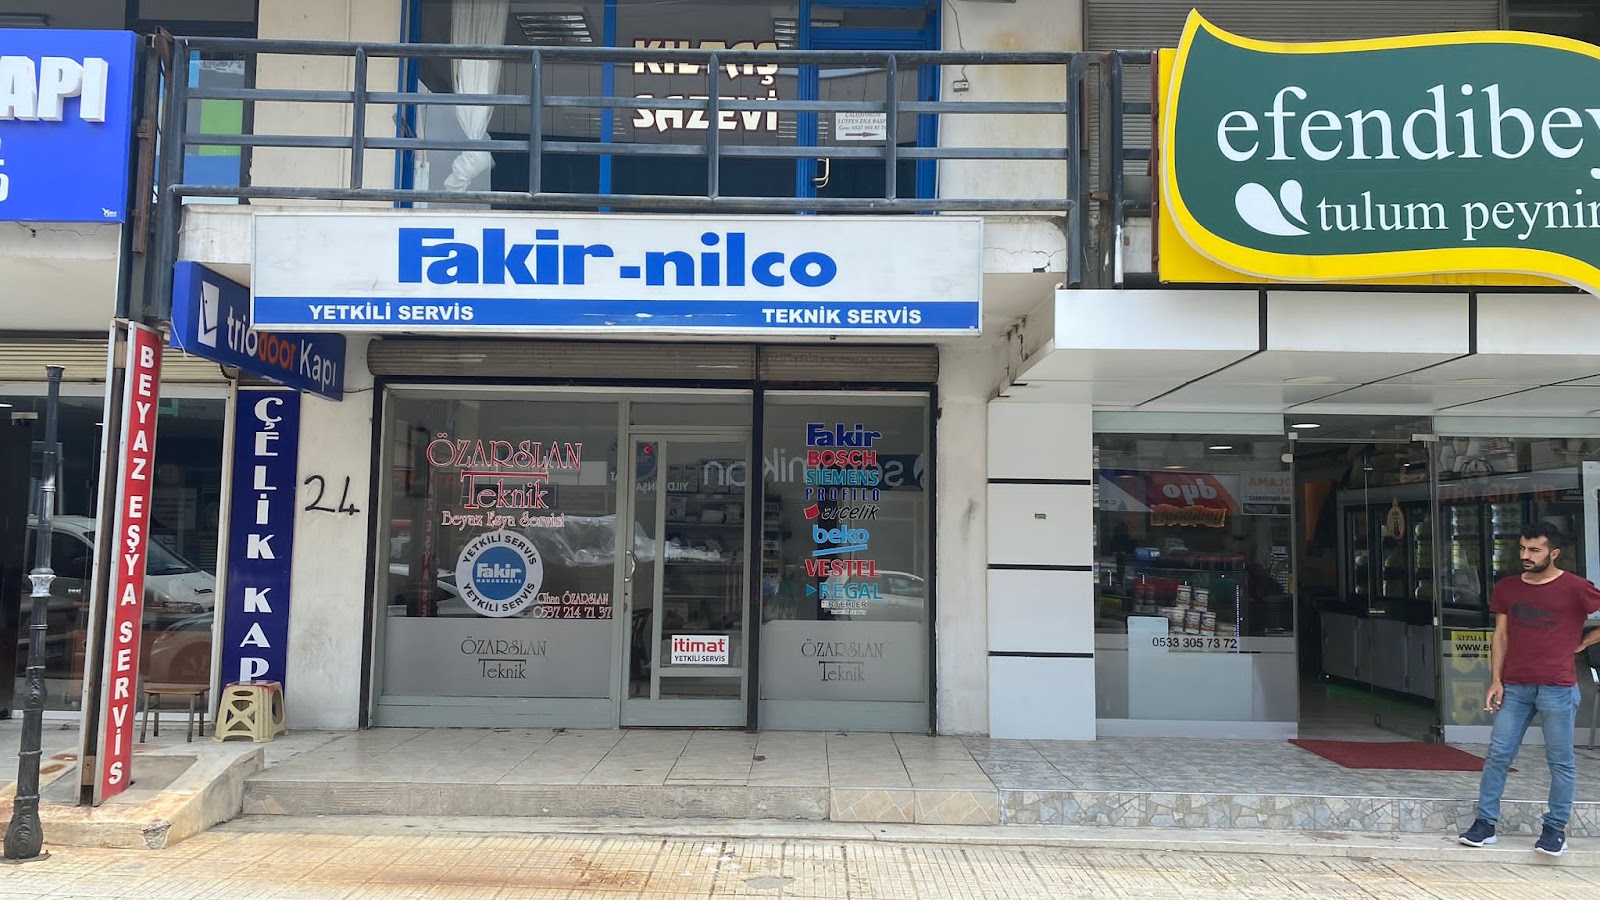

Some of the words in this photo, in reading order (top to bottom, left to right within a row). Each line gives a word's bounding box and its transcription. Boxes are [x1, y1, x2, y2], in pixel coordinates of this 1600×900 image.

[632, 89, 778, 132] SAZEVİ
[1316, 191, 1449, 231] tulum
[309, 302, 391, 320] YETKİLİ
[398, 302, 474, 320] SERVİS
[762, 306, 841, 324] TEKNİK
[847, 306, 922, 324] SERVİS
[300, 339, 337, 392] Kapı
[131, 345, 155, 480] BEYAZ
[806, 422, 882, 447] Fakir
[426, 432, 583, 471] ÖZARSLAN
[807, 450, 877, 467] BOSCH
[246, 397, 283, 560] ÇELİK
[805, 468, 880, 486] SIEMENS
[303, 474, 360, 516] 24
[460, 470, 549, 509] Teknik
[805, 487, 880, 501] PROFILO
[441, 510, 483, 531] Beyaz
[519, 510, 565, 528] Servisi
[821, 504, 880, 523] arçelik
[812, 524, 870, 544] beko
[120, 495, 144, 606] EŞYA
[463, 532, 501, 564] YETKİLİ
[504, 535, 538, 566] SERVİS
[476, 563, 522, 578] Fakir
[805, 559, 881, 578] VESTEL
[463, 583, 499, 612] YETKİLİ
[502, 582, 535, 612] SERVİS
[562, 591, 609, 605] ÖZARSLAN
[819, 582, 884, 600] REGAL
[533, 606, 561, 619] 0537
[563, 606, 581, 619] 214
[584, 606, 596, 619] 71
[599, 606, 612, 619] 37
[460, 635, 547, 656] ÖZARSLAN
[674, 638, 725, 652] itimat
[801, 638, 883, 658] ÖZARSLAN
[1152, 637, 1179, 648] 0533
[1183, 638, 1203, 648] 305
[1207, 638, 1220, 648] 73
[1223, 638, 1238, 649] 72
[478, 658, 527, 679] Teknik
[818, 661, 865, 681] Teknik
[108, 621, 133, 786] SERVİS
